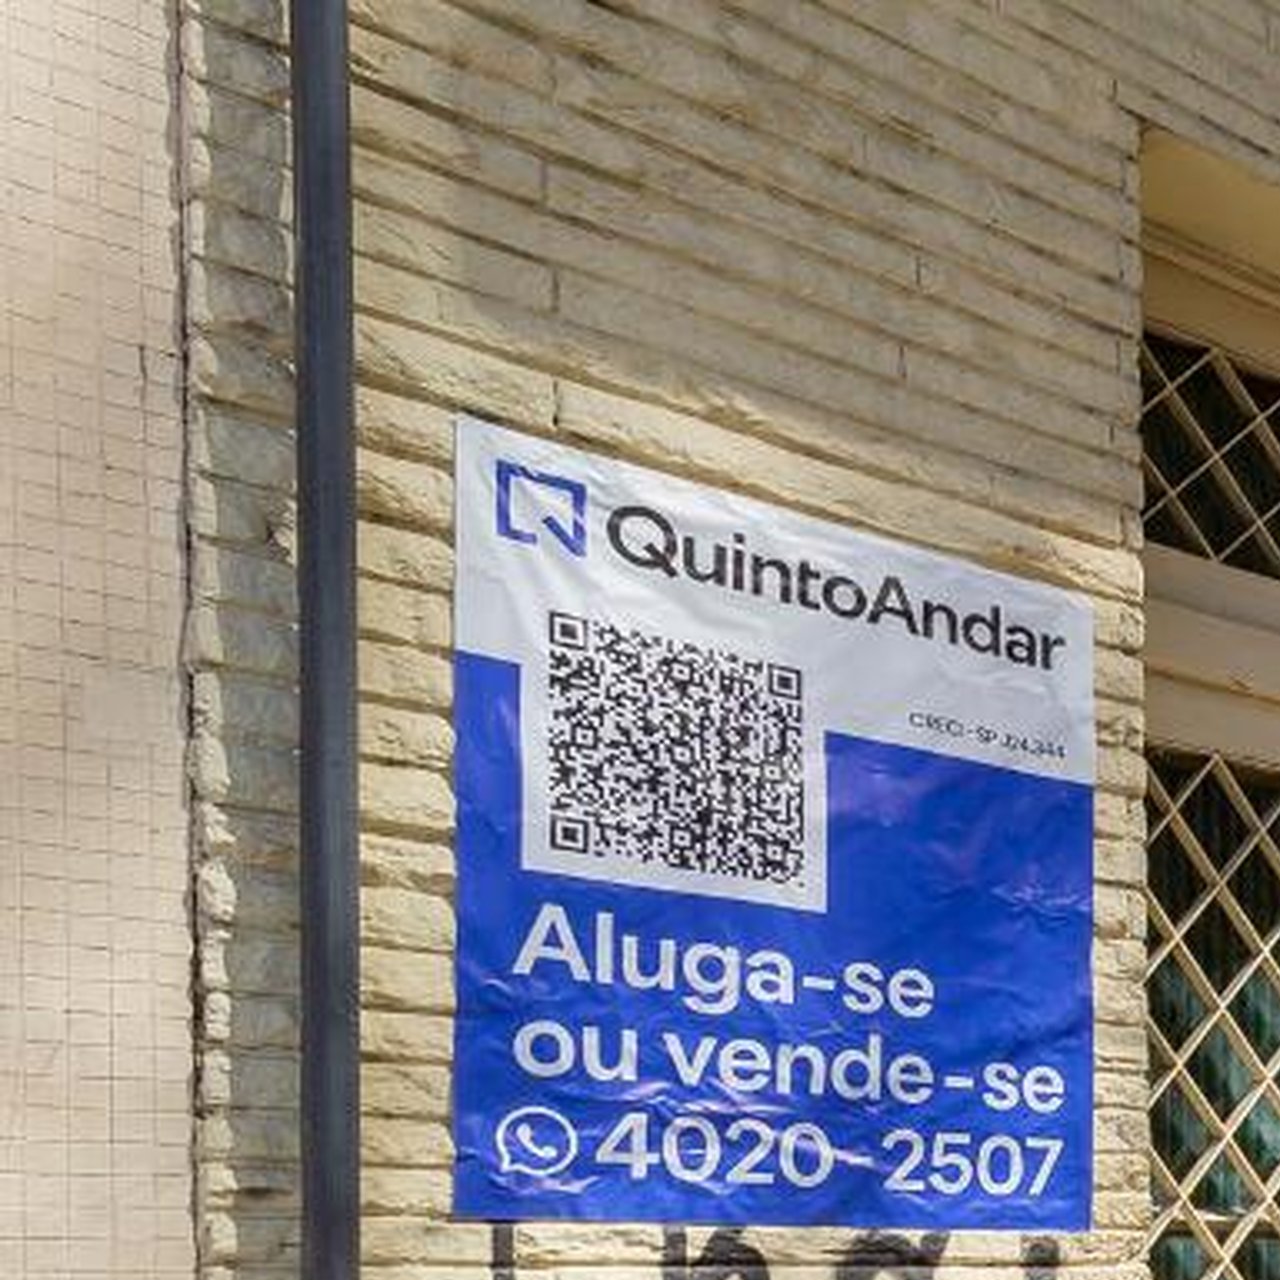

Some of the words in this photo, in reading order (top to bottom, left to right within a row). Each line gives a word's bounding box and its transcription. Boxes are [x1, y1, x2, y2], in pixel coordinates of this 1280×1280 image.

[606, 504, 1066, 673] QuintoAndar
[511, 902, 936, 1019] Aluga-se
[513, 1018, 641, 1084] ou
[662, 1032, 1066, 1115] vende-se
[595, 1110, 1066, 1198] 4020-2507
